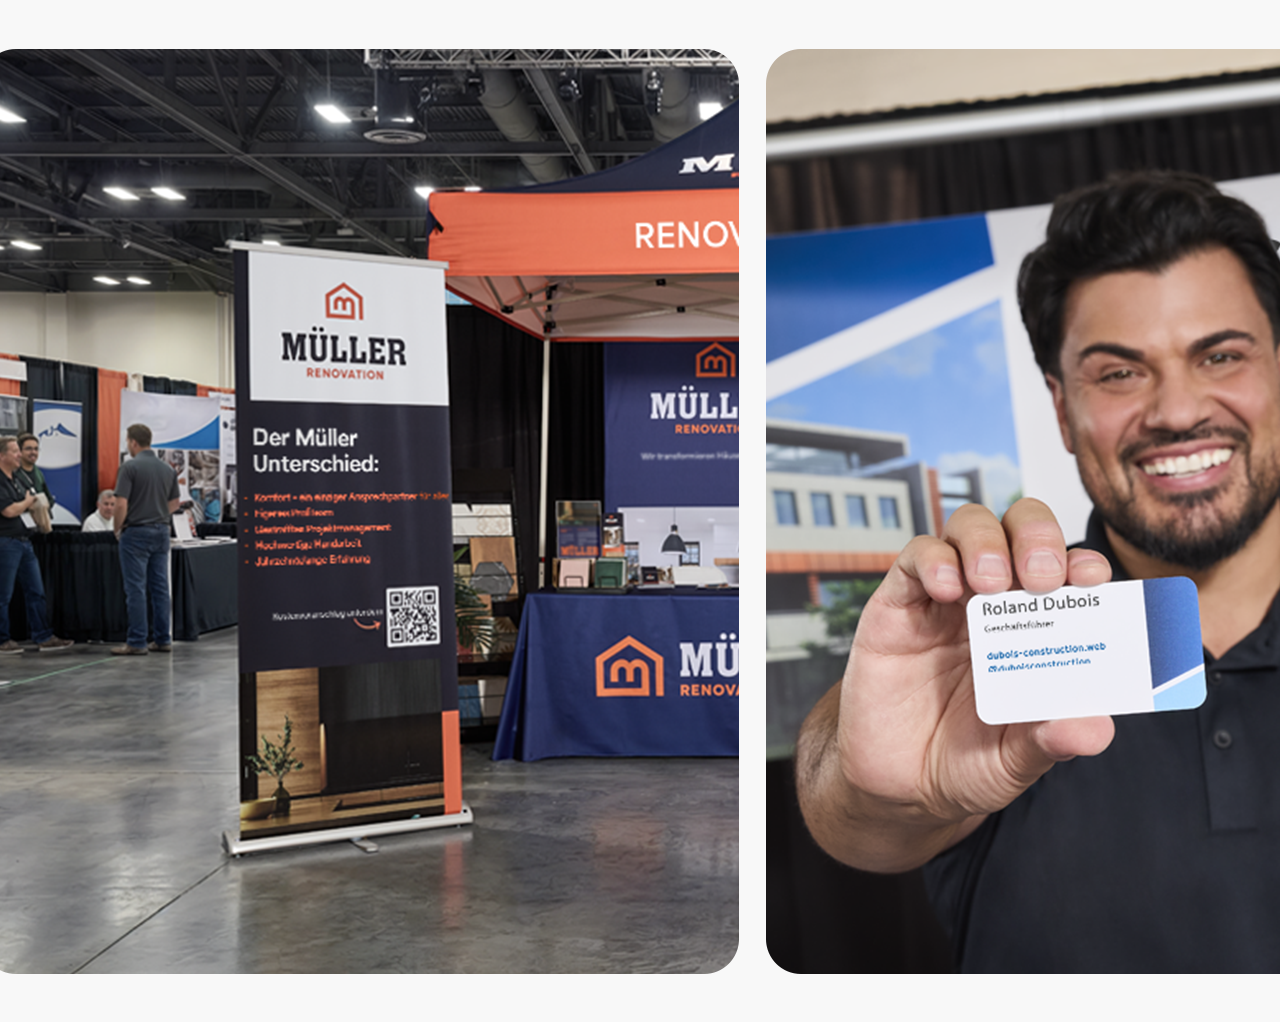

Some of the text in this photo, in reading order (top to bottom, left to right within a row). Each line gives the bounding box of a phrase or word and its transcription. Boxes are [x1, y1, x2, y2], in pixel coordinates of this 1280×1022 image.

[281, 326, 407, 365] MÜLLER
[306, 367, 384, 380] RENOVATION
[650, 385, 738, 419] MÜLL
[253, 428, 358, 447] Der Müller
[675, 424, 739, 434] RENOVATI
[253, 453, 379, 472] Unterschied:
[982, 593, 1100, 616] Roland Dubois
